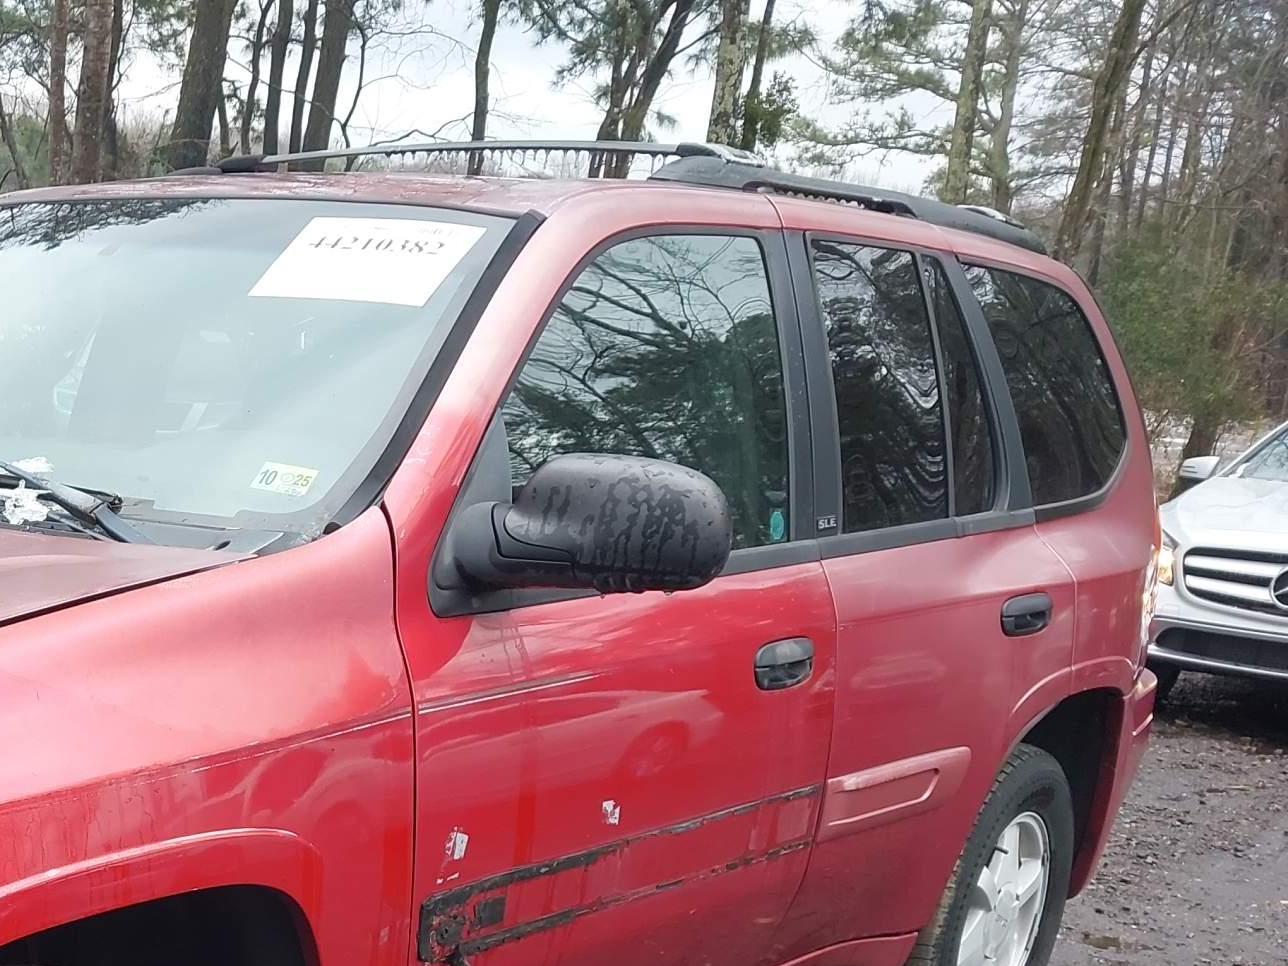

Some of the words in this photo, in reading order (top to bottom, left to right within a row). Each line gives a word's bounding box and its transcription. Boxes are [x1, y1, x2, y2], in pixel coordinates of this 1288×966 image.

[309, 235, 446, 255] 44210382
[258, 468, 279, 486] 10
[291, 473, 313, 487] 25
[818, 518, 838, 529] SLE
